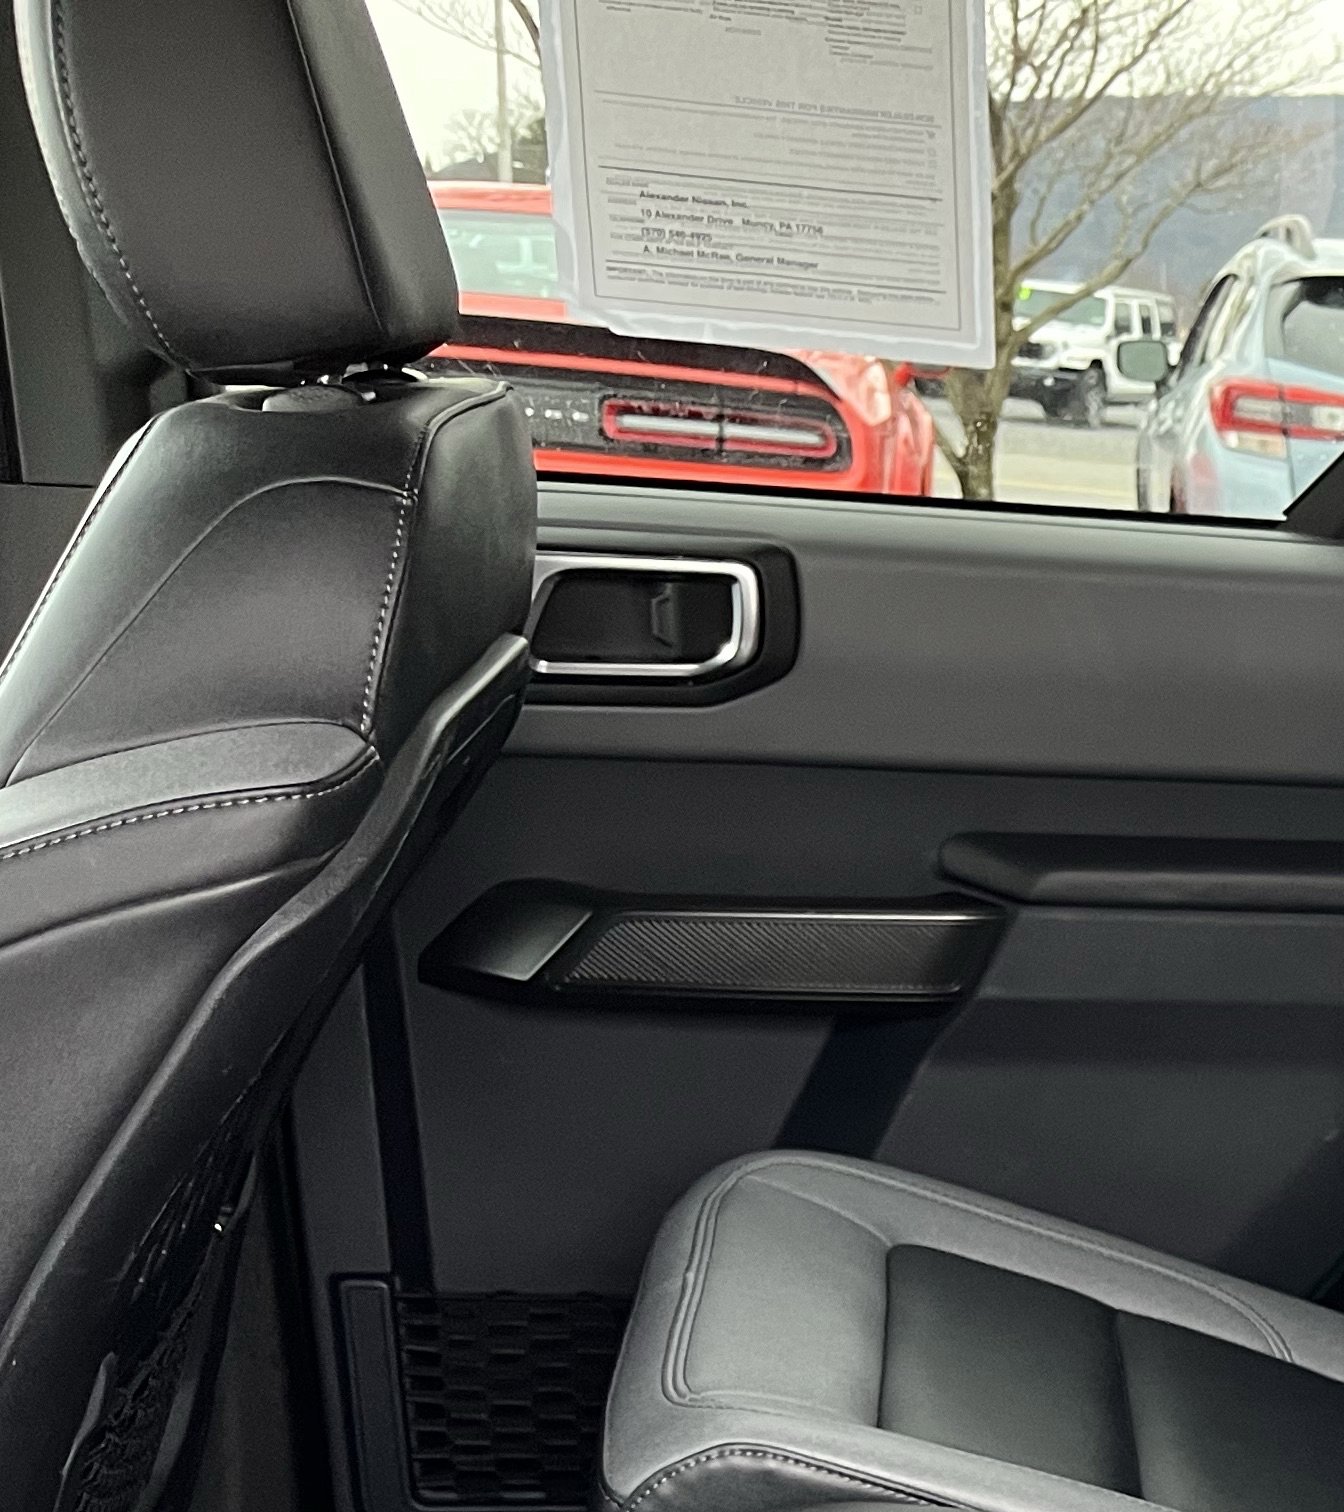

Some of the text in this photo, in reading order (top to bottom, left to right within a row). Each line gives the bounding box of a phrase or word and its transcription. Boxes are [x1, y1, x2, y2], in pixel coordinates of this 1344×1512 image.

[639, 190, 689, 203] Alexander
[655, 209, 704, 224] Alexander
[779, 221, 793, 231] PA
[656, 245, 694, 258] Michael
[735, 252, 774, 266] General
[776, 255, 819, 270] Manager
